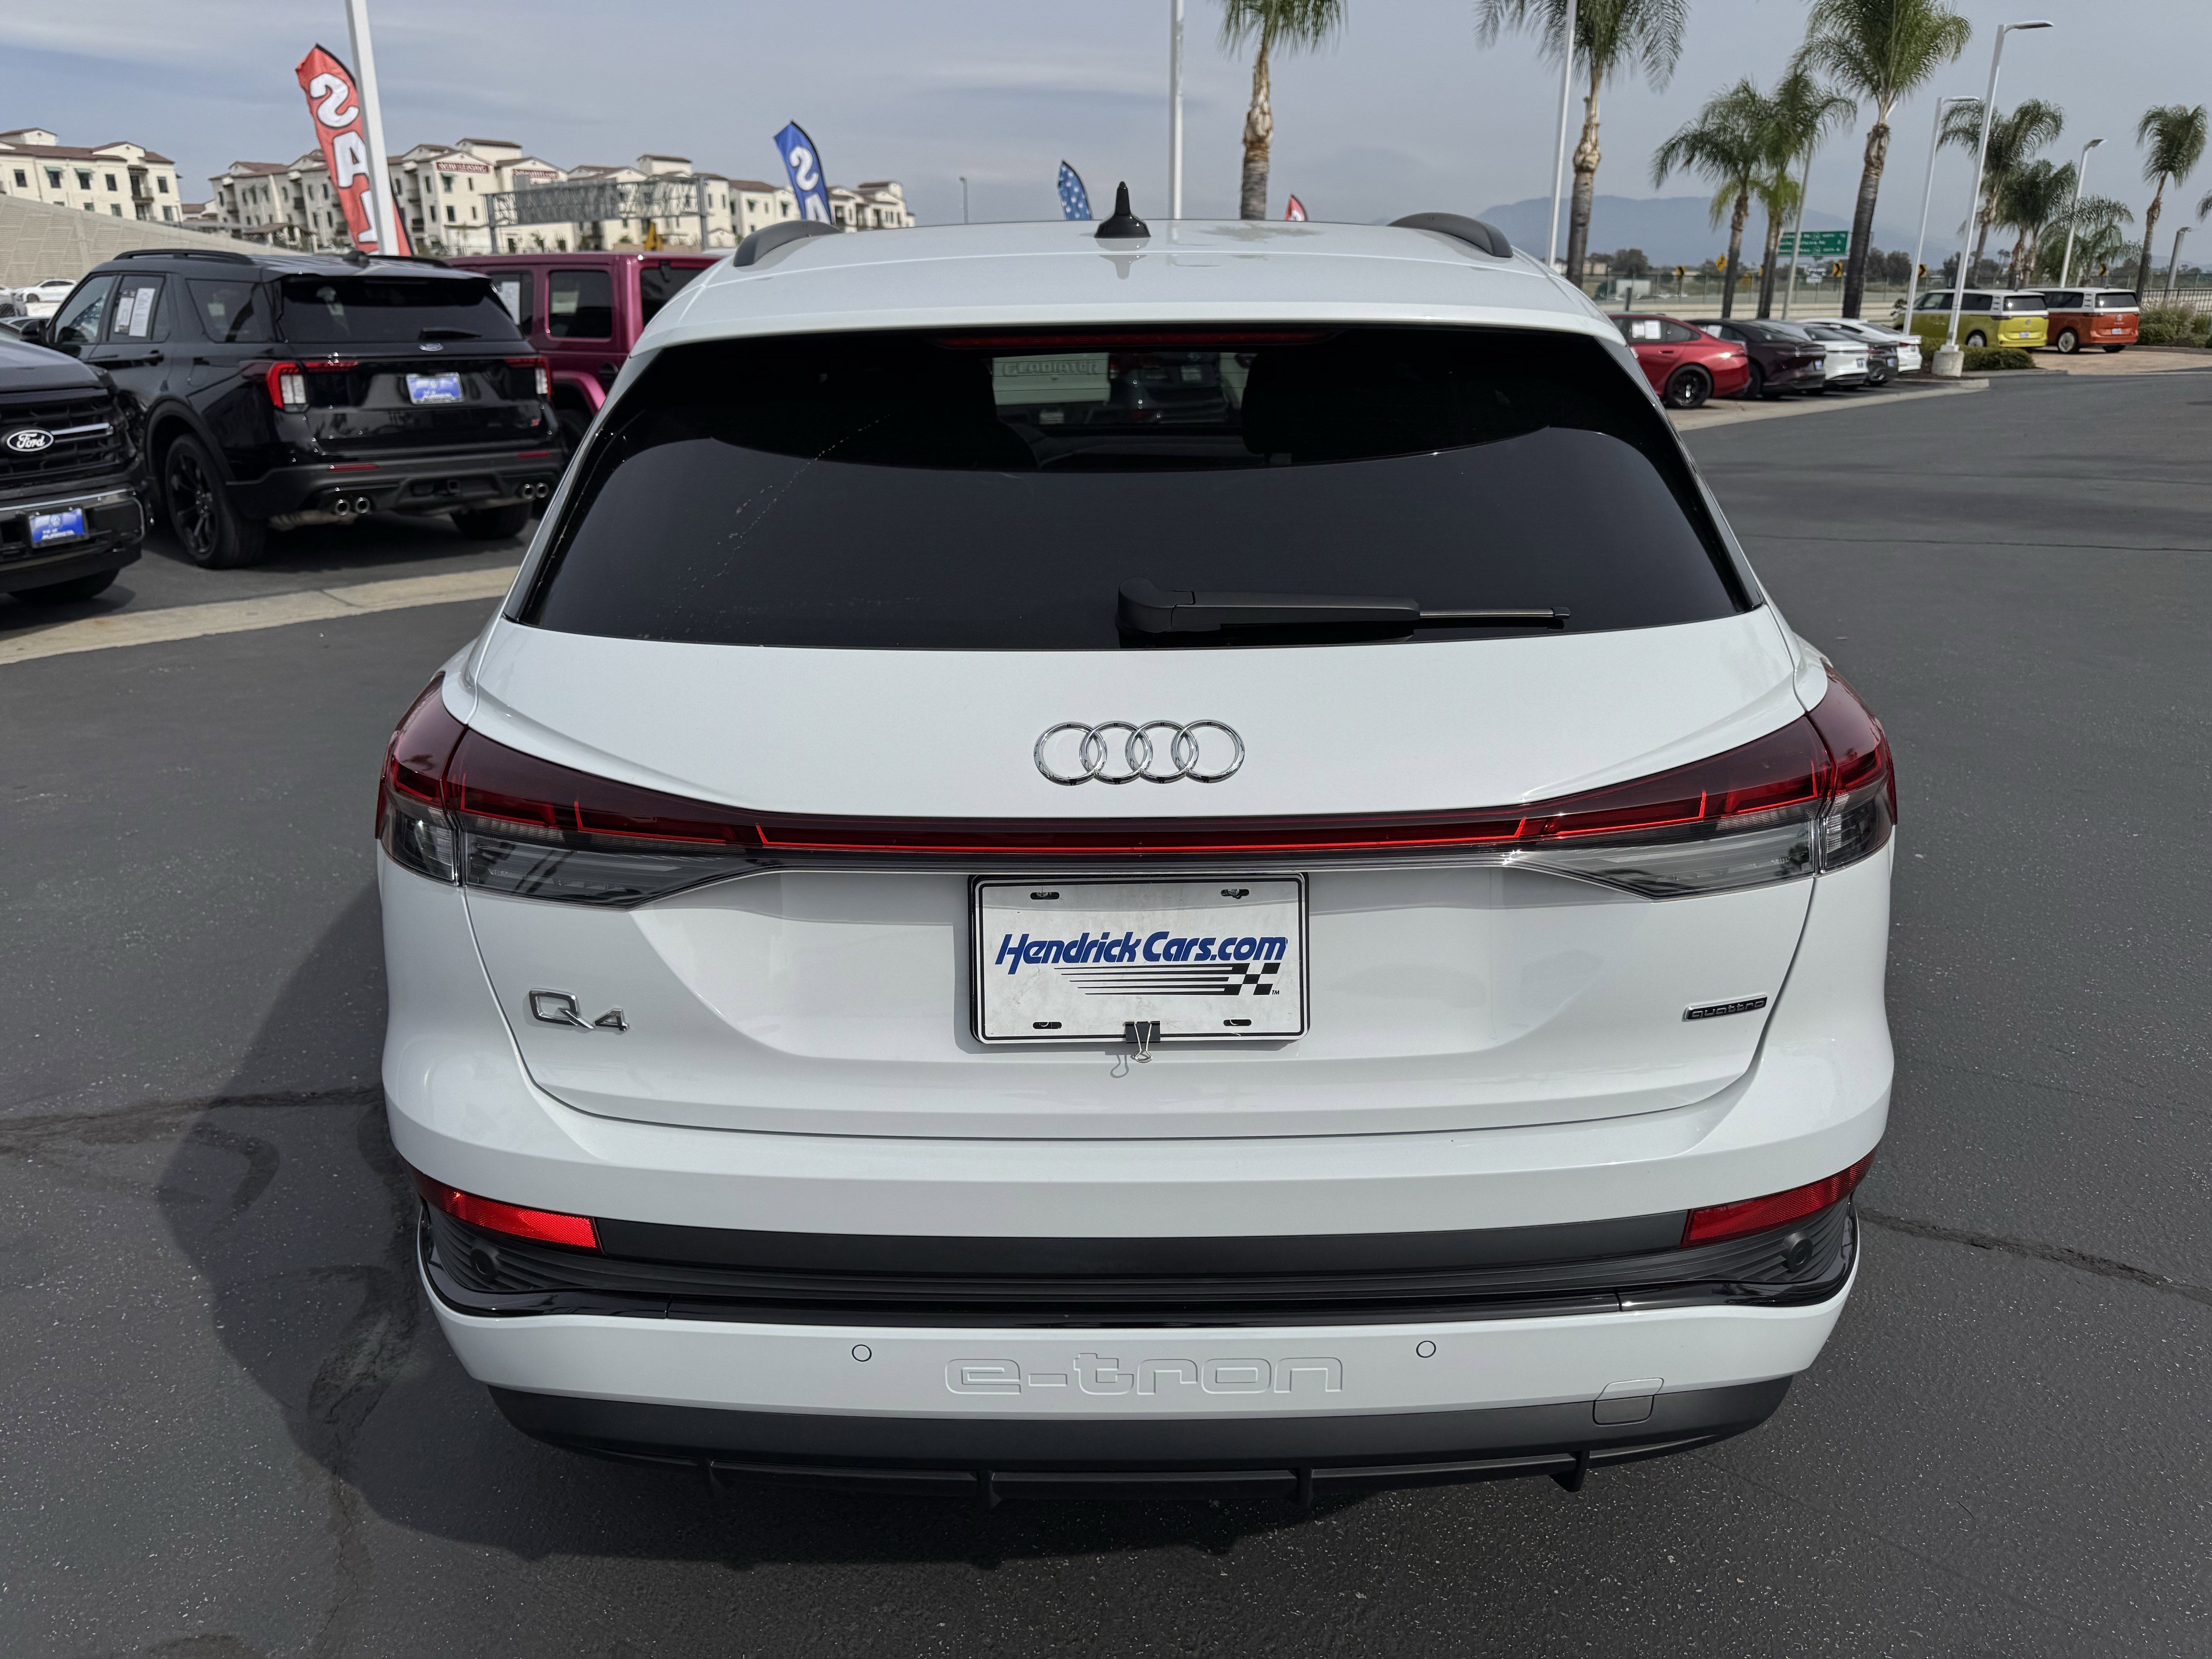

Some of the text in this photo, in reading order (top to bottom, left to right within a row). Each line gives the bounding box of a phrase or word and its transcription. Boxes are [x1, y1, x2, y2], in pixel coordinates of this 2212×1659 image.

[17, 433, 45, 448] Ford
[529, 988, 630, 1031] Q4
[1692, 1000, 1764, 1018] quattro
[945, 1353, 1343, 1395] e-tron
